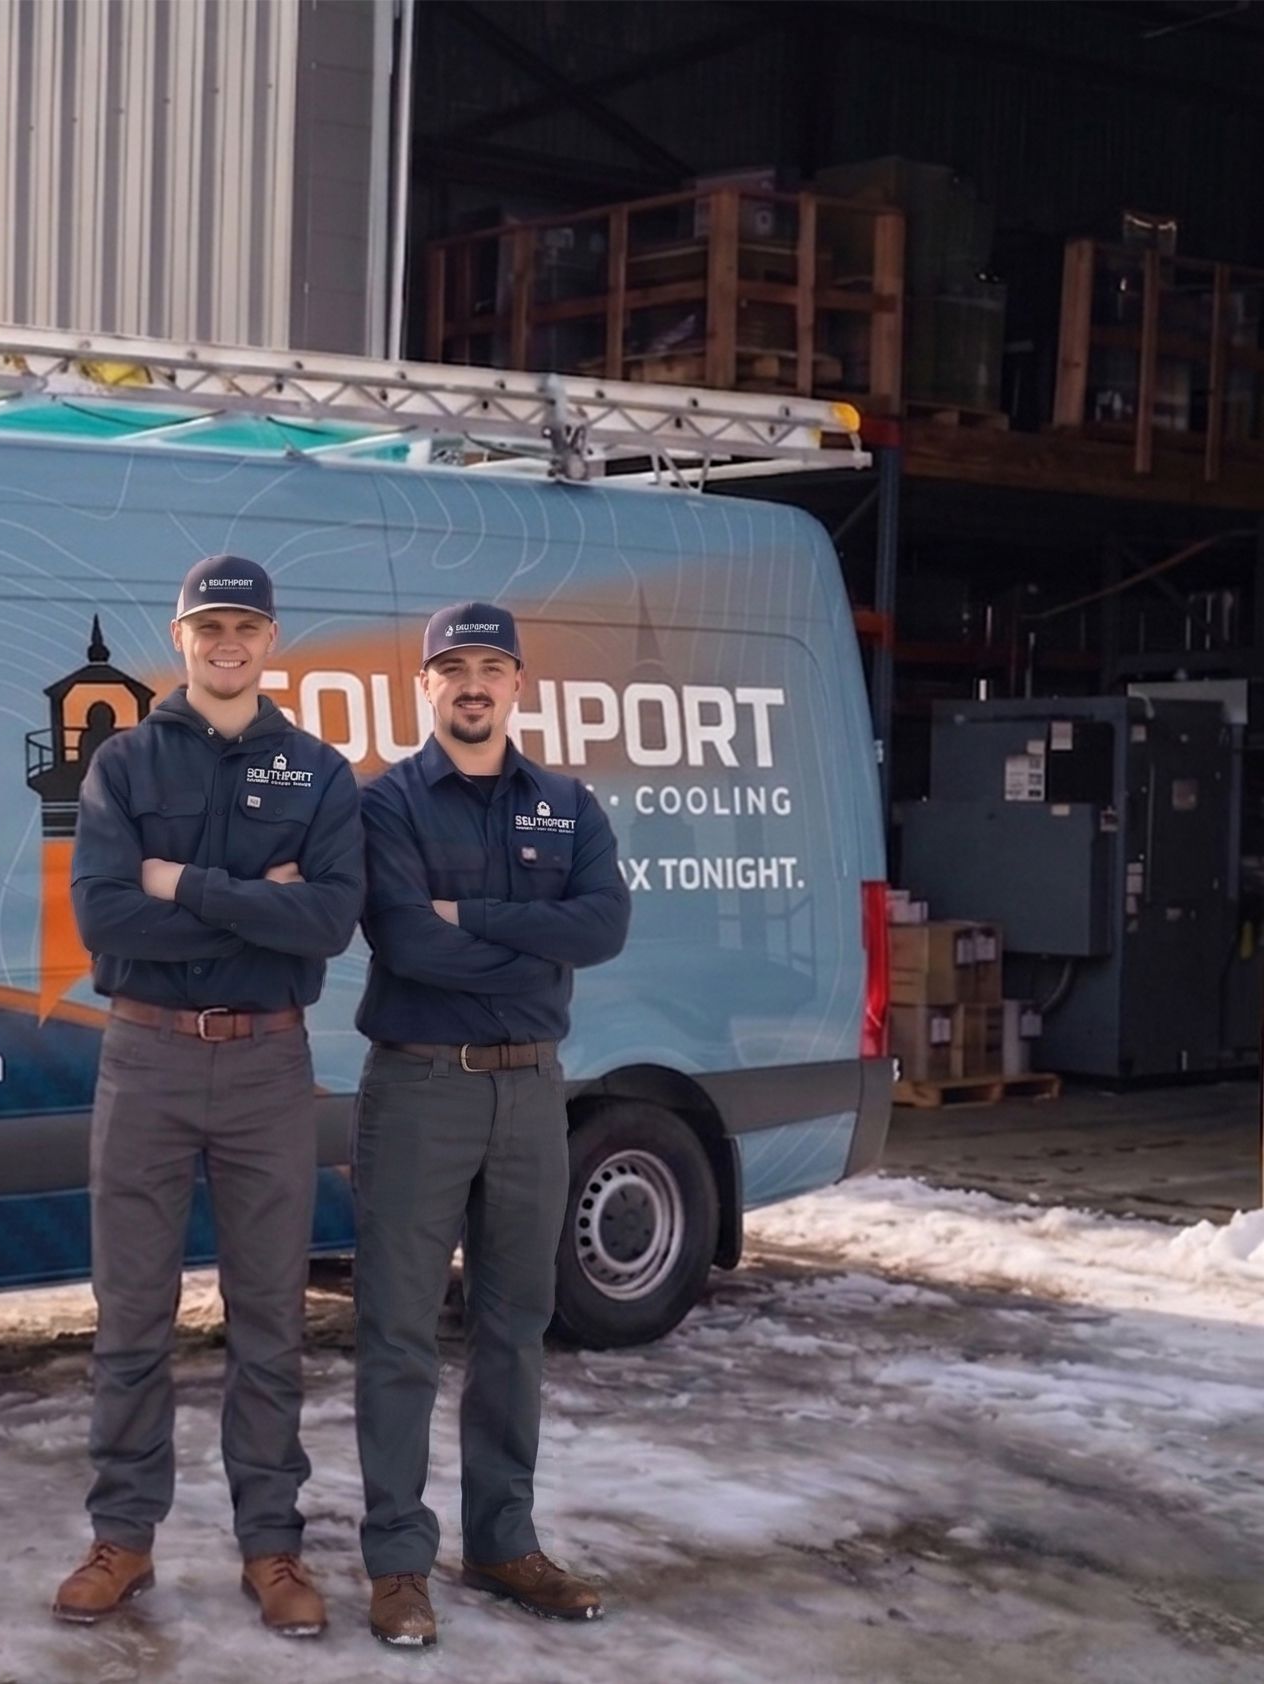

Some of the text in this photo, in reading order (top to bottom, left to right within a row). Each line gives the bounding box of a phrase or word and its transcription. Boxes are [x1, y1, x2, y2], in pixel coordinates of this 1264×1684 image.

[259, 670, 785, 768] OUHPORT
[635, 786, 791, 815] COOLING
[658, 857, 805, 890] TONIGHT.
